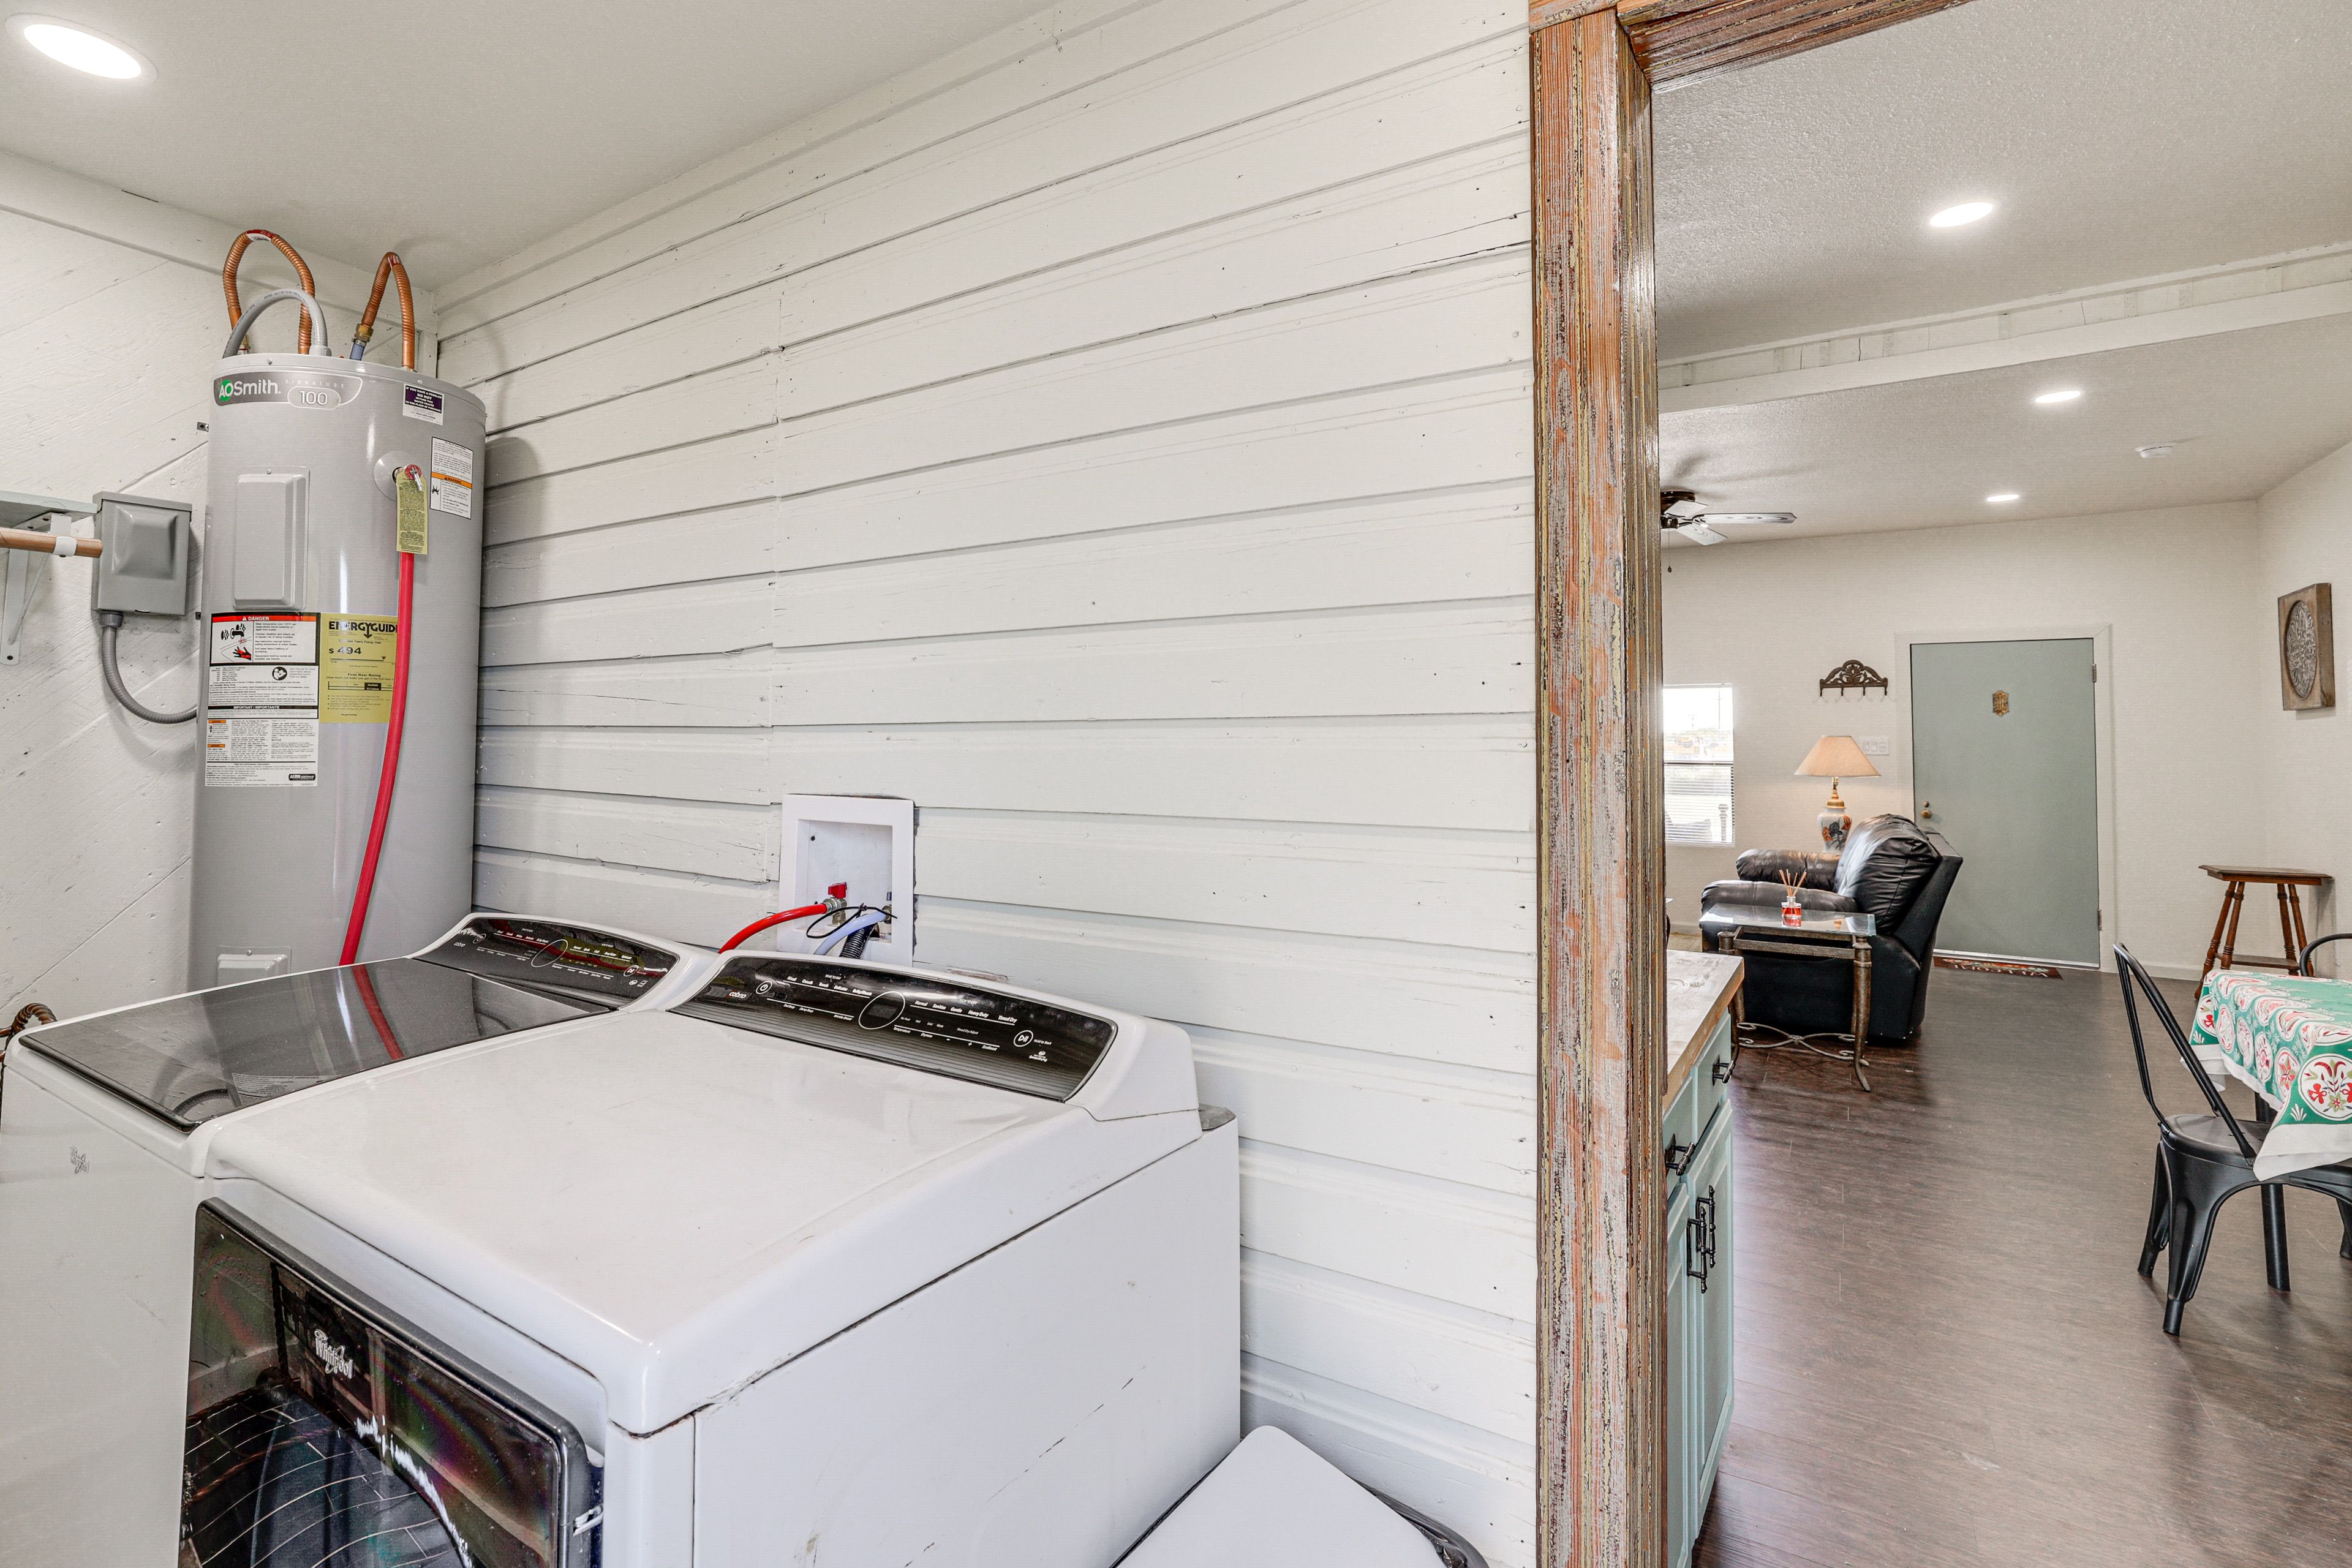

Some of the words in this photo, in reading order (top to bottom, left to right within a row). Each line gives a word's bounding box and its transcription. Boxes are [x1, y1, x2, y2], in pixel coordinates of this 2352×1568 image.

[285, 379, 345, 388] SIGNATURE
[300, 390, 328, 405] 100
[314, 1329, 353, 1379] Whirlpool
